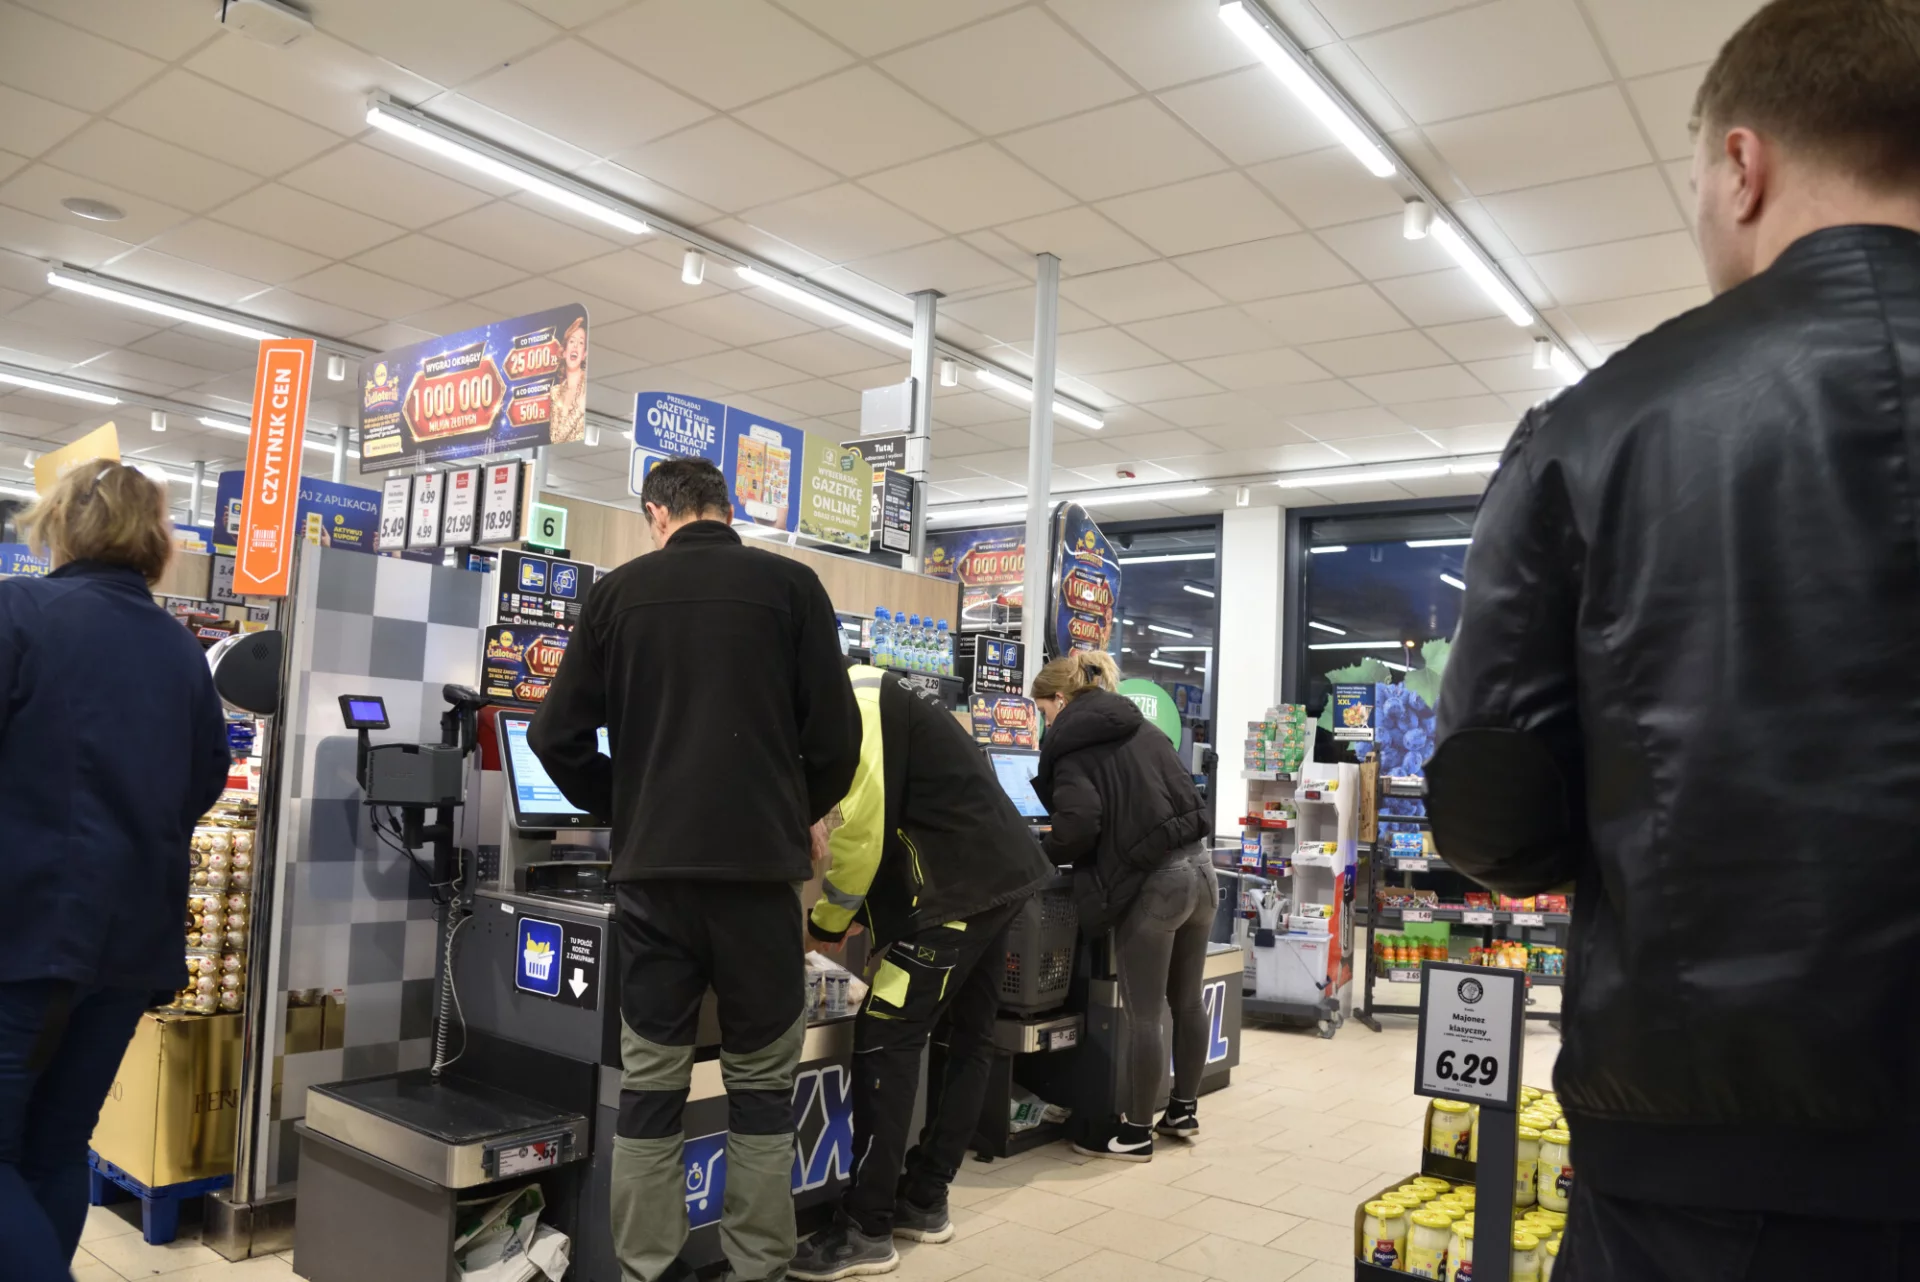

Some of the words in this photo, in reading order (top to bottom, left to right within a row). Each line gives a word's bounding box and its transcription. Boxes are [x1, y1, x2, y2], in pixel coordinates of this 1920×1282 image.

[426, 360, 451, 373] WYGRAJ
[511, 352, 525, 375] 25
[527, 346, 551, 370] 000
[271, 368, 292, 409] CEN
[413, 389, 420, 422] 1
[423, 382, 455, 419] 000
[458, 373, 493, 412] 000
[520, 402, 539, 422] 500
[656, 399, 694, 419] GAZETKI
[666, 395, 702, 411] PRZEGLĄDAJ
[647, 407, 716, 445] ONLINE
[653, 426, 663, 437] W
[663, 429, 708, 451] APLIKACJI
[659, 438, 679, 452] LIDL
[680, 444, 701, 457] PLUS
[874, 442, 894, 453] Tutaj
[261, 413, 287, 505] CZYTNIK
[420, 490, 436, 505] 4.99
[811, 475, 864, 506] GAZETKĘ
[315, 491, 323, 503] Z
[323, 494, 378, 516] APLIKACJĄ
[812, 494, 860, 521] ONLINE,
[381, 516, 405, 538] 5.49
[445, 514, 472, 534] 21.99
[485, 510, 512, 531] 18.99
[543, 517, 555, 538] 6
[333, 526, 363, 537] AKTYWUJ
[333, 532, 360, 542] KUPONY
[416, 525, 432, 539] 4.99
[12, 562, 21, 572] Z
[219, 564, 235, 576] 3.4
[965, 558, 971, 576] 1
[973, 556, 997, 575] 000
[1000, 554, 1024, 573] 000
[533, 646, 538, 665] 1
[520, 685, 531, 697] 25
[925, 678, 939, 690] 2.29
[1418, 912, 1432, 920] 1.49
[570, 936, 577, 945] TU
[577, 938, 593, 948] POŁÓŻ
[571, 945, 590, 955] KOSZYK
[1406, 972, 1420, 980] 2.65
[1452, 1012, 1486, 1024] Majonez
[1448, 1023, 1488, 1037] klasyczny
[1435, 1049, 1499, 1086] 6.29
[1374, 1252, 1398, 1261] Majonez
